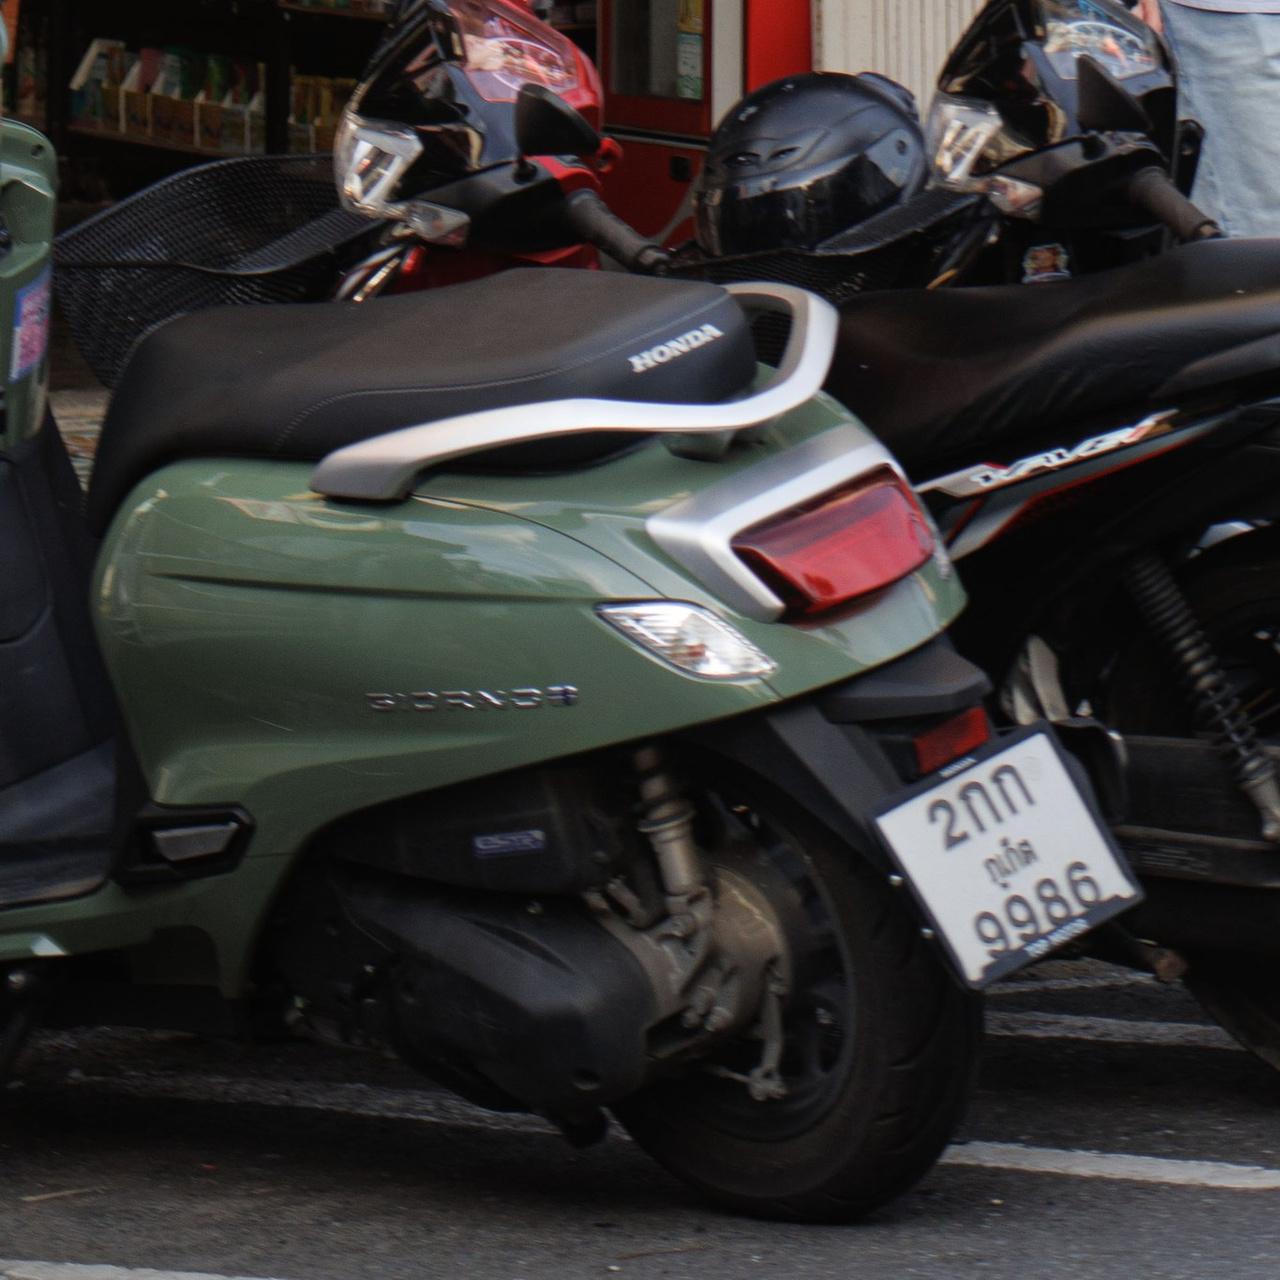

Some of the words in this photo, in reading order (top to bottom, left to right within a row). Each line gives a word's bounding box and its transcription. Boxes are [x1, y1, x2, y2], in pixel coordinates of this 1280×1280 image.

[628, 323, 724, 373] HONDA
[927, 763, 1035, 851] 2กก
[982, 836, 1039, 890] ภูเก็ต
[974, 861, 1101, 960] 9986
